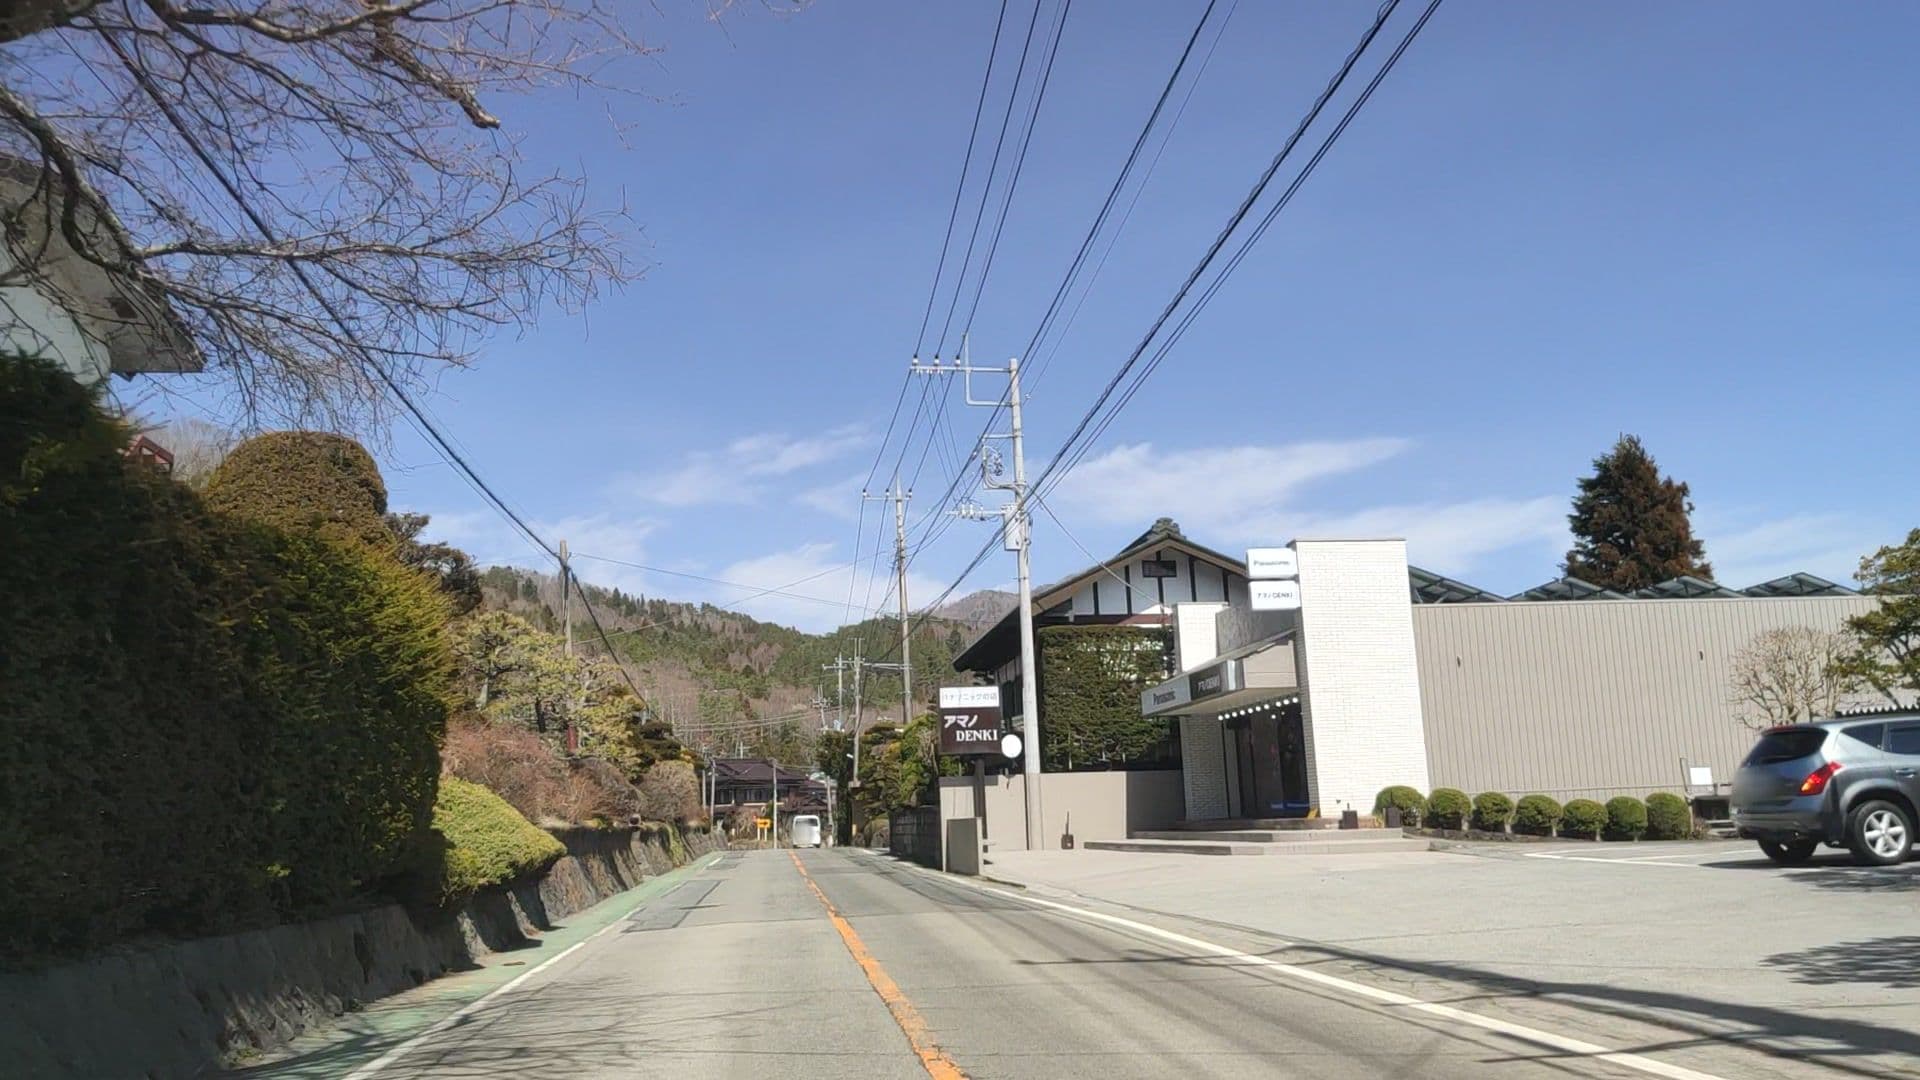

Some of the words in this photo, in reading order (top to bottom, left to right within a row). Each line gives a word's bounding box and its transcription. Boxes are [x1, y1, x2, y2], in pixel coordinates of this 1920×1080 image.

[944, 714, 978, 728] アマノ
[956, 729, 998, 741] DENKI
